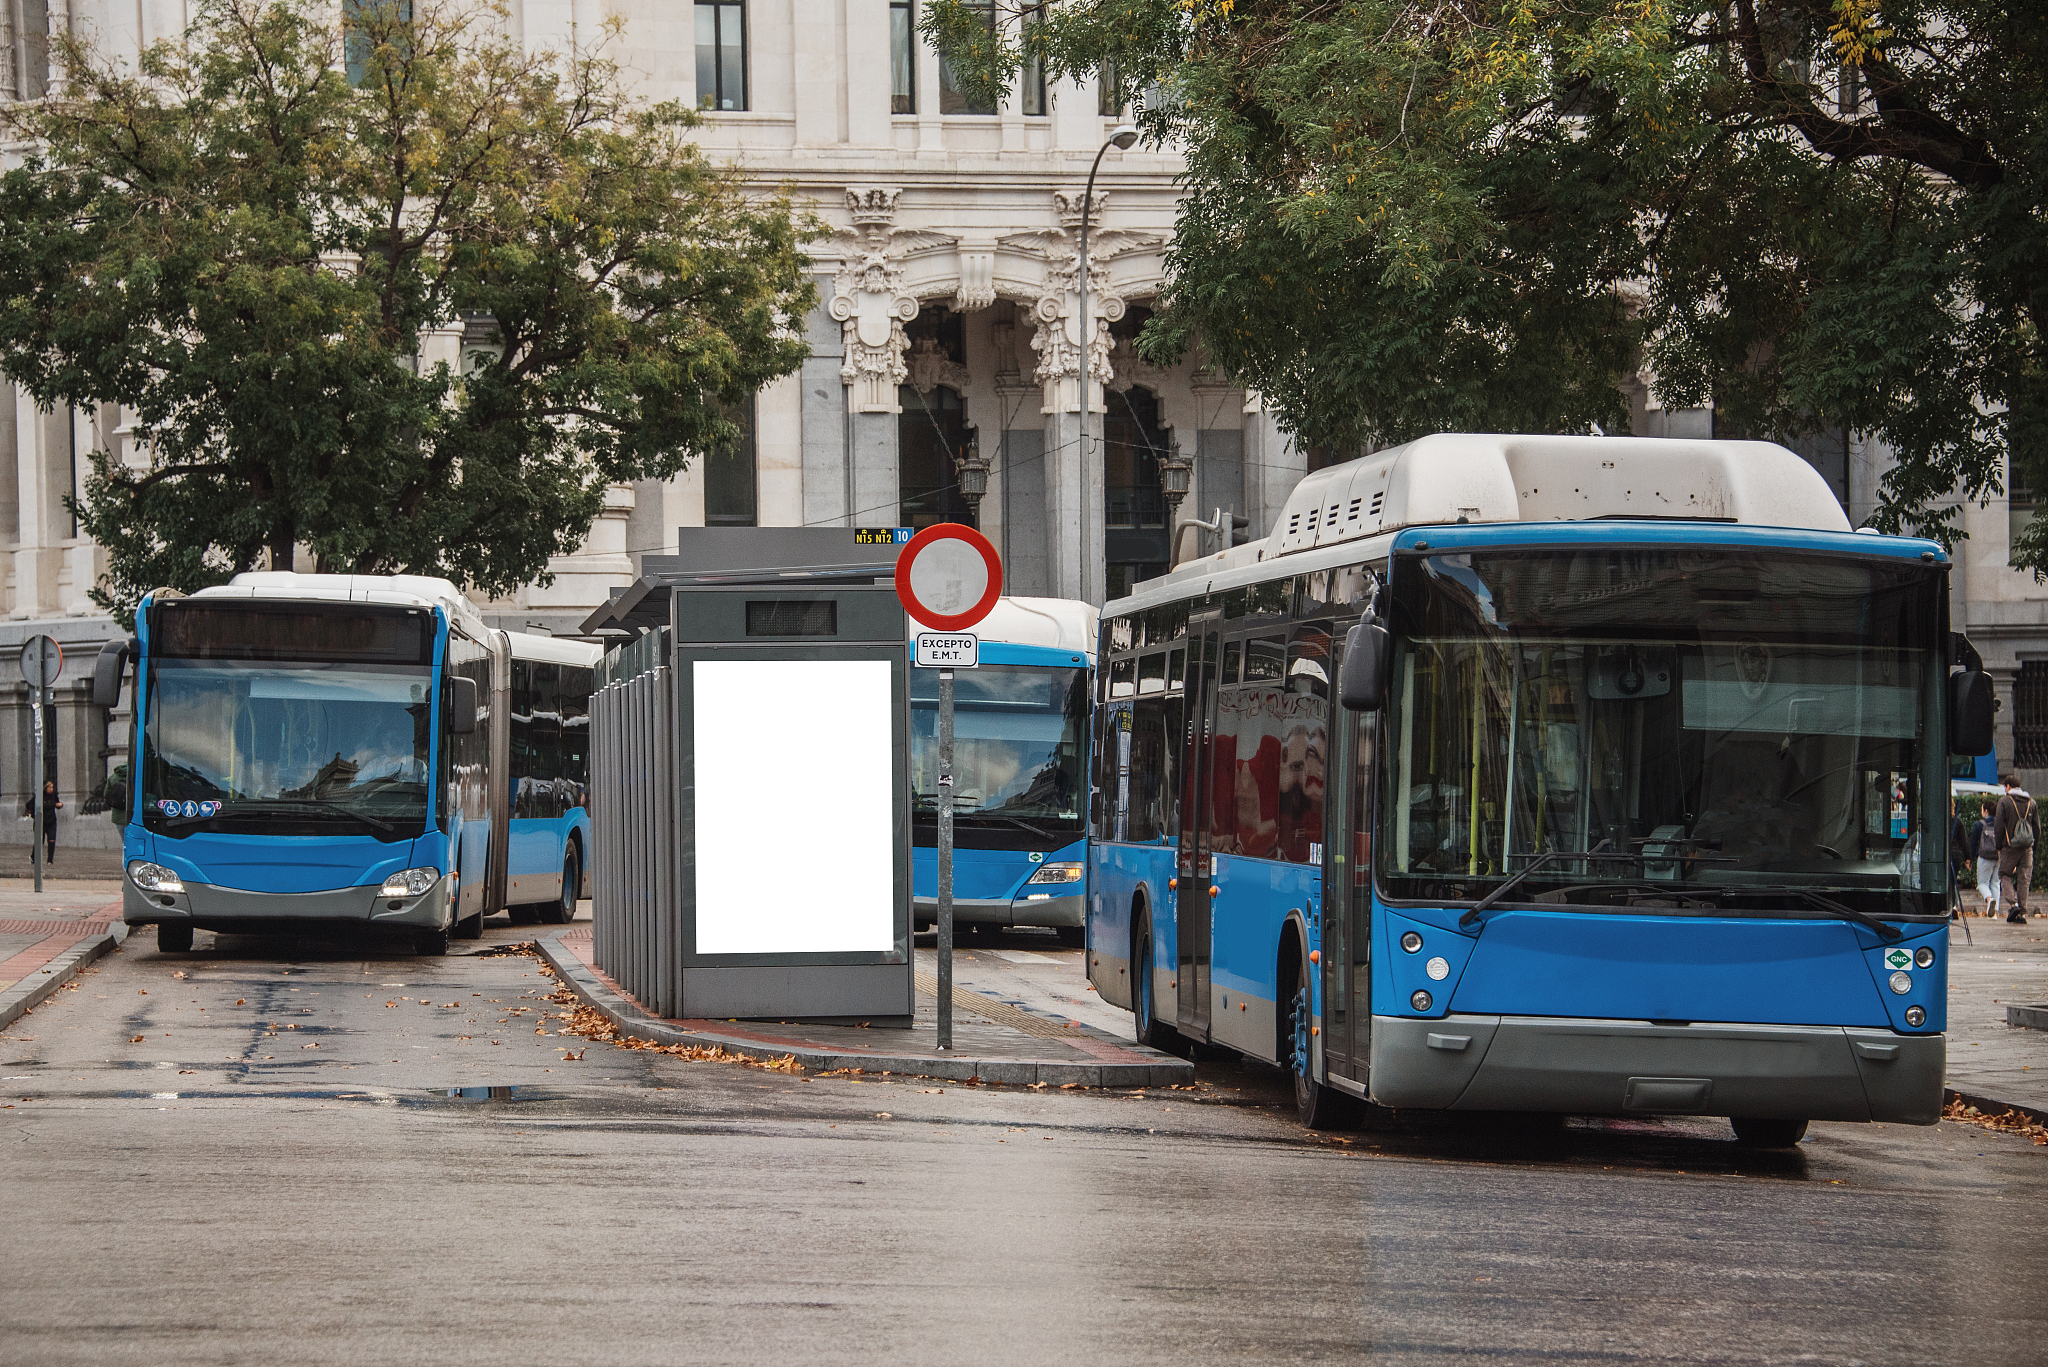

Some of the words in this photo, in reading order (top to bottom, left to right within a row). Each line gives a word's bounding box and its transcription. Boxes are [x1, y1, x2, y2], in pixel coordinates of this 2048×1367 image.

[856, 533, 872, 544] N15
[875, 533, 892, 544] N12
[897, 531, 909, 542] 10
[922, 639, 972, 649] EXCEPTO
[932, 651, 962, 660] E.M.T.
[1890, 955, 1908, 963] GNC
